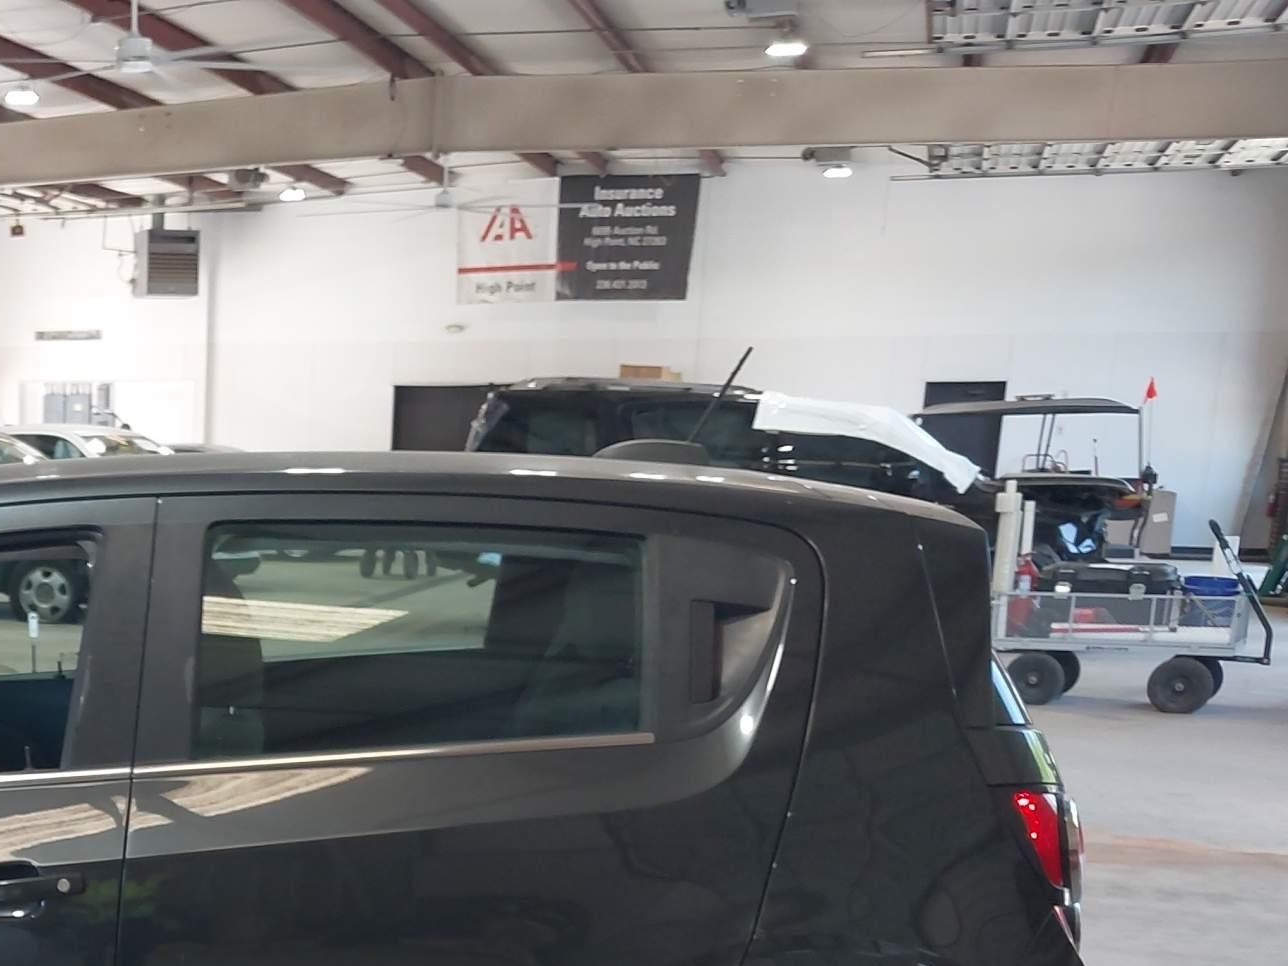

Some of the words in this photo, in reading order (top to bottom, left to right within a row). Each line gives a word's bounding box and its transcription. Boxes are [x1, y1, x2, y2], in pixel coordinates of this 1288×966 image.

[594, 186, 664, 201] Insurance
[579, 203, 612, 218] Auto
[614, 202, 676, 217] Auctions
[475, 281, 503, 295] High
[505, 280, 537, 293] Point
